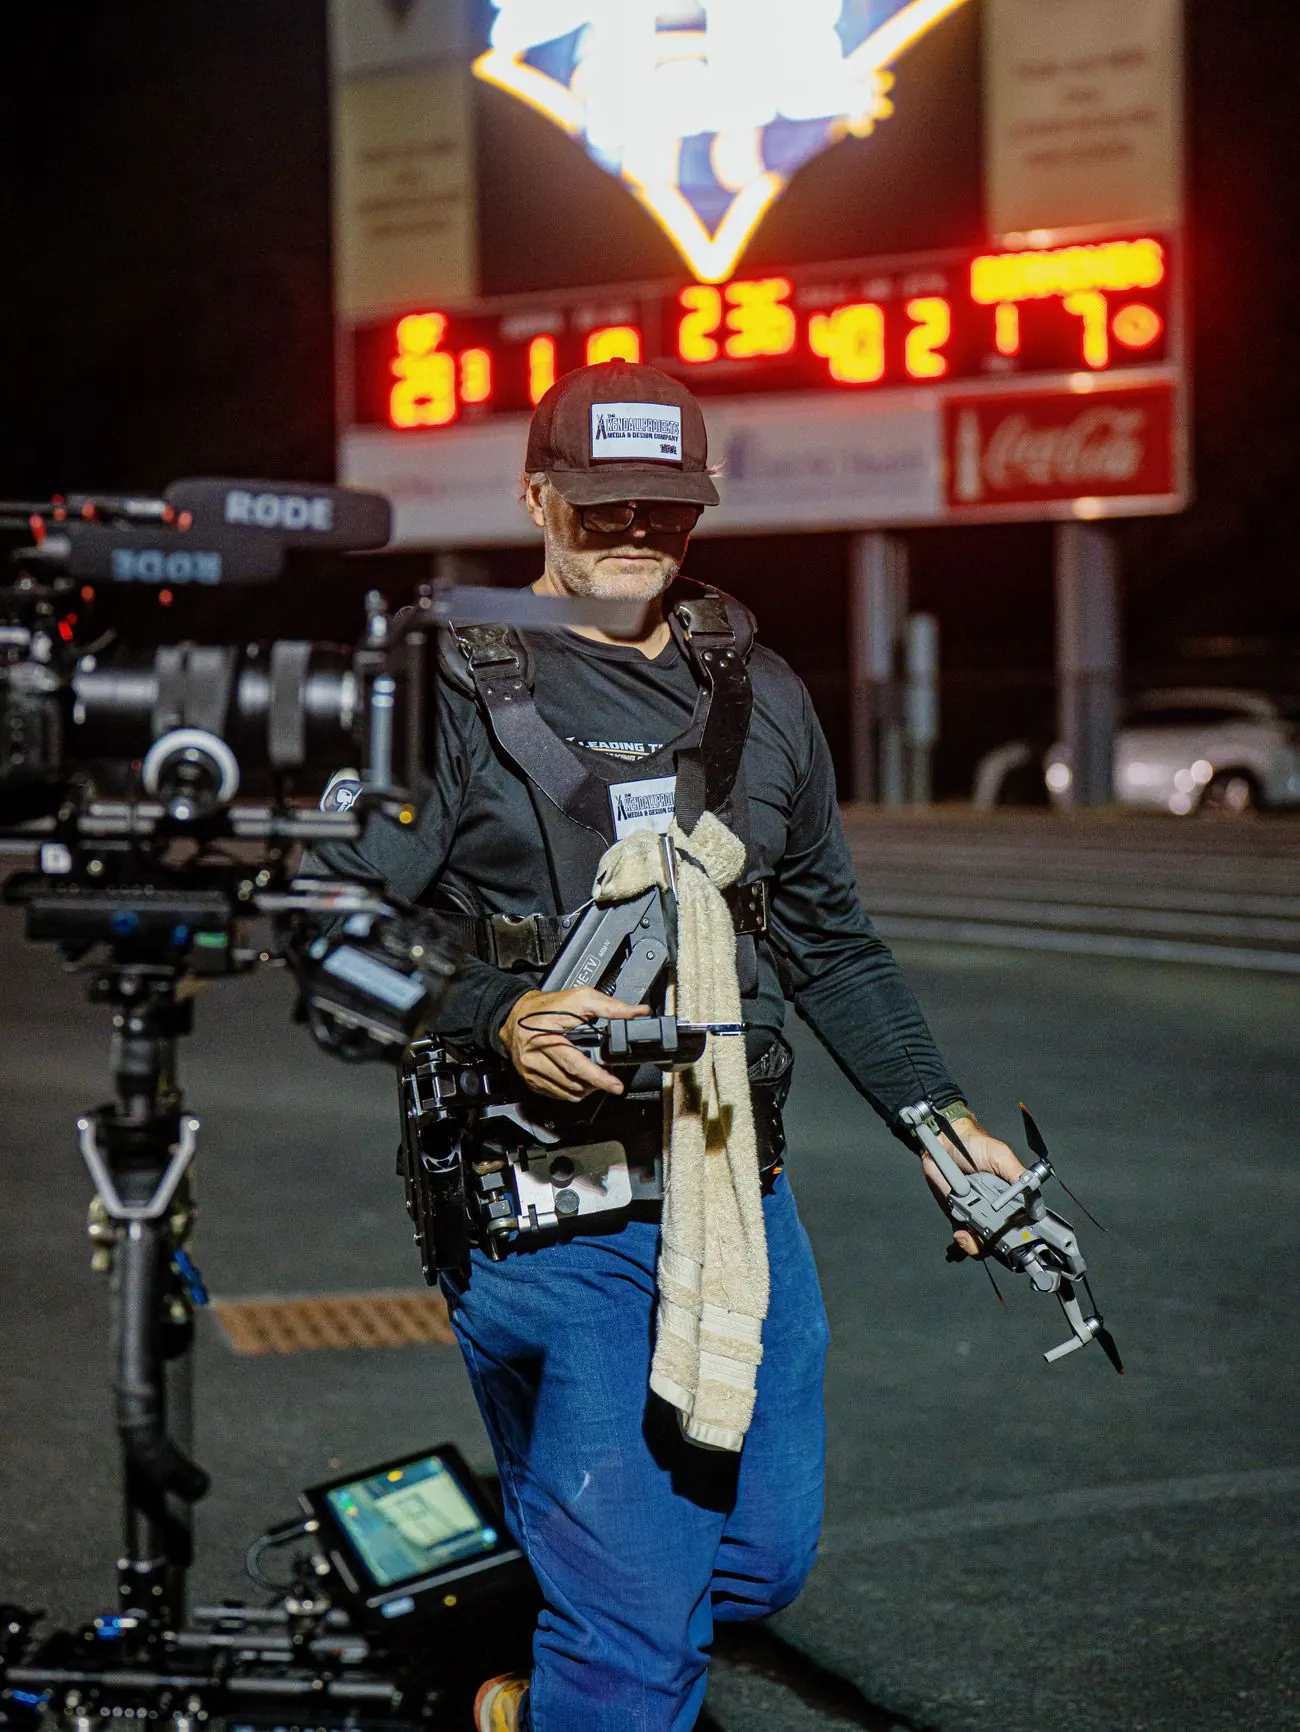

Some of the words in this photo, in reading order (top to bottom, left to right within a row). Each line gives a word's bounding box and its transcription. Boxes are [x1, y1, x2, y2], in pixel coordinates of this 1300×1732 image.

[607, 431, 626, 439] MEDIA
[632, 432, 653, 440] DESIGN
[654, 433, 679, 442] COMPANY
[224, 489, 334, 532] RODE
[647, 743, 663, 753] T
